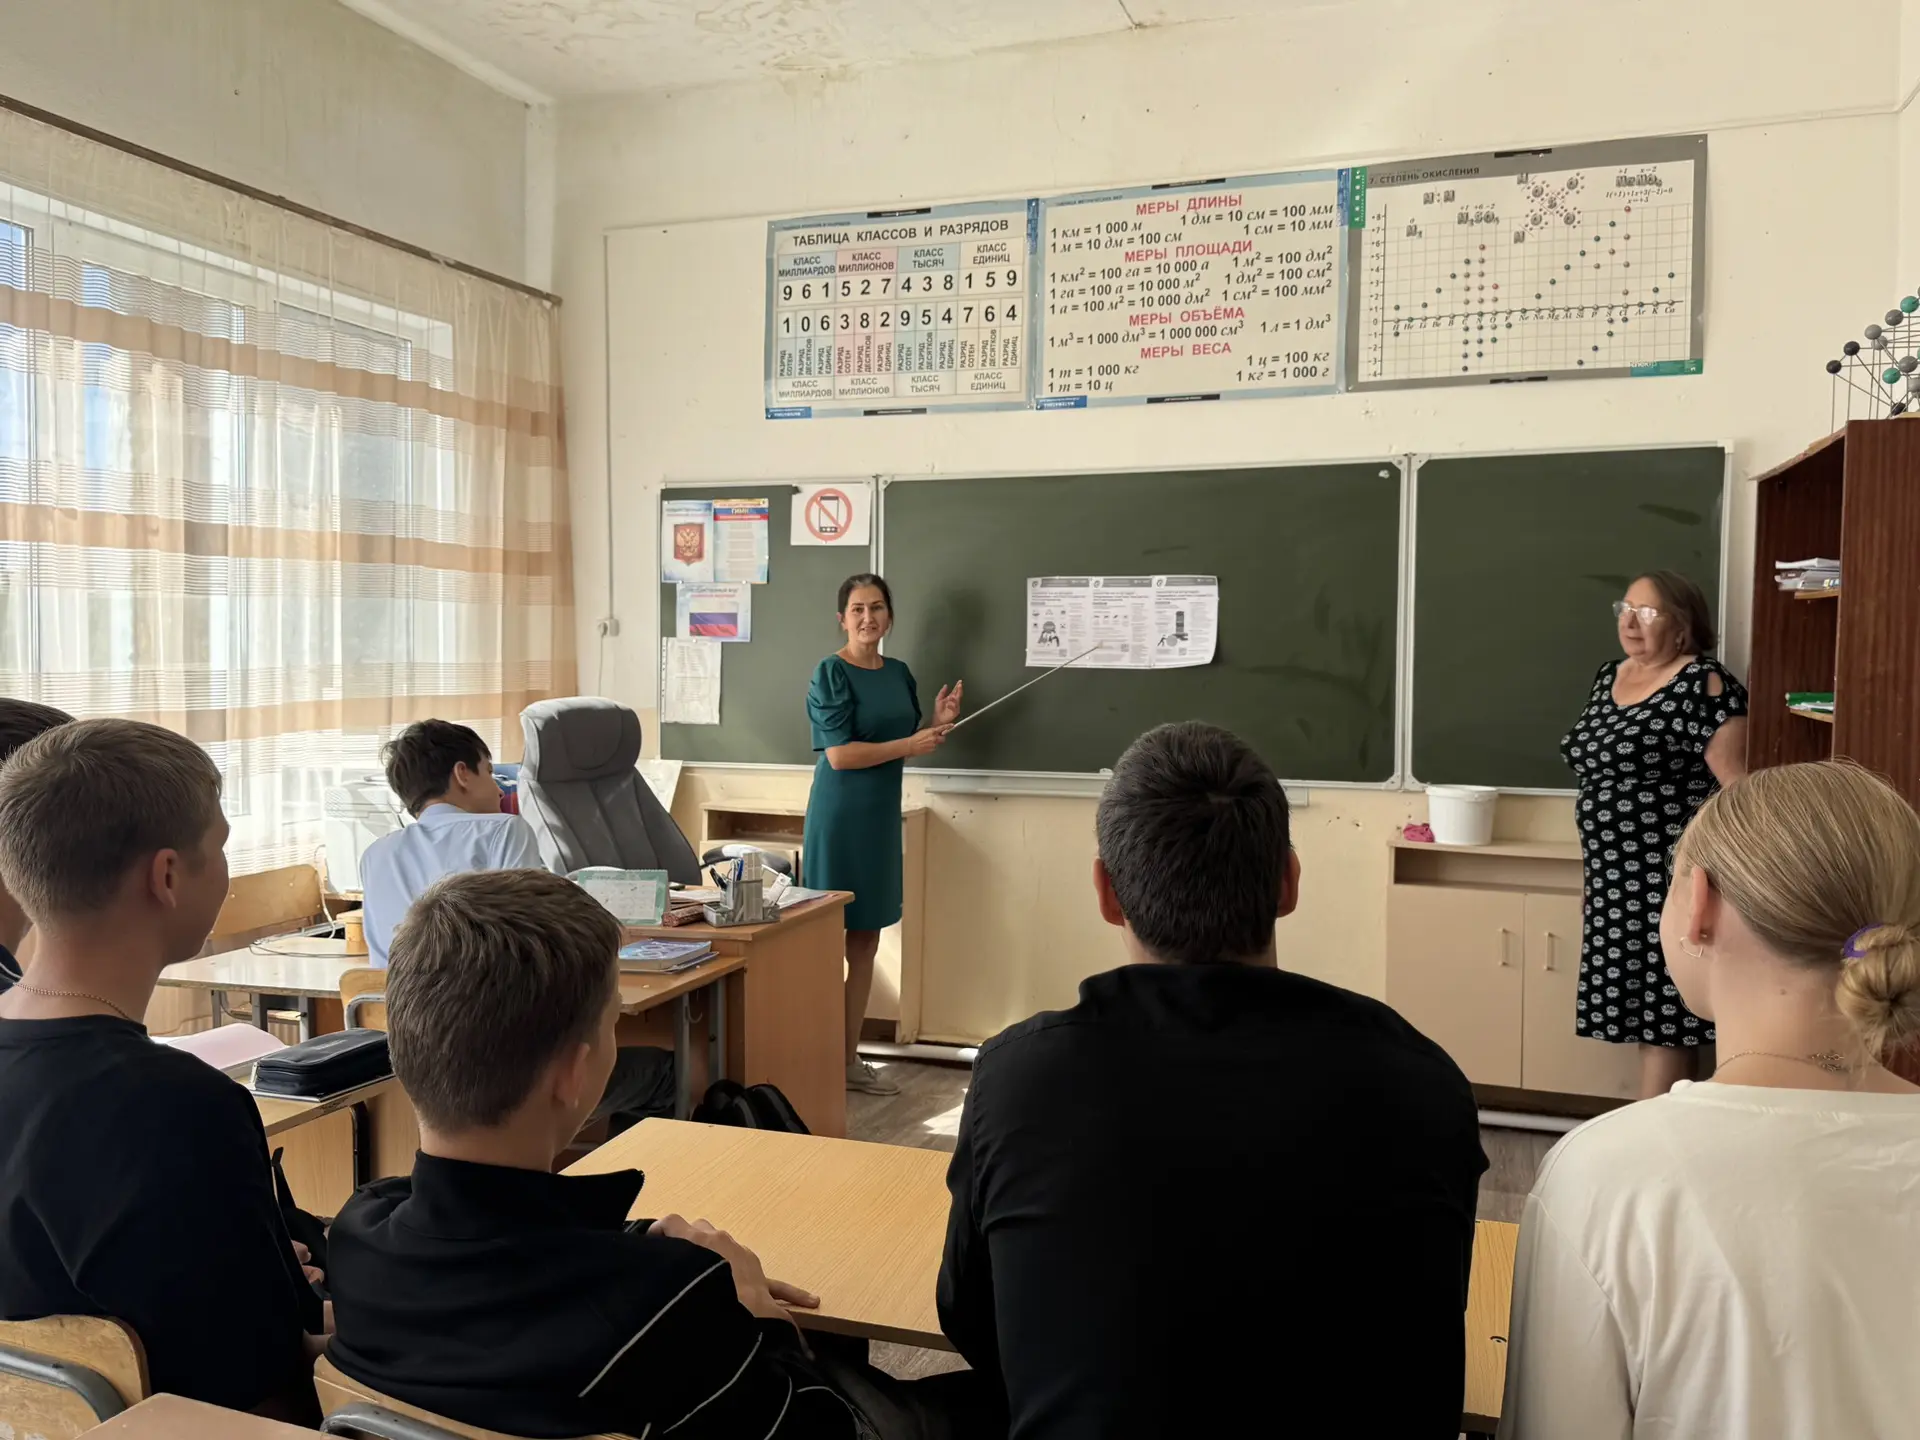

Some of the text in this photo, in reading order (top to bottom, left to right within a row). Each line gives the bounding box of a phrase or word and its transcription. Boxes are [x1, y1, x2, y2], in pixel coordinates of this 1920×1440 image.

[1380, 173, 1419, 184] СТЕПЕНЬ
[1422, 167, 1480, 178] ОКИСЛЕНИЯ
[1136, 200, 1179, 215] МЕРЫ
[1187, 195, 1242, 212] ДЛИНЫ
[1191, 212, 1211, 225] дм
[1228, 210, 1243, 222] 10
[1247, 210, 1265, 221] см
[1282, 205, 1306, 218] 100
[1309, 204, 1333, 216] мм
[793, 220, 1009, 247] ТАБЛИЦА КЛАССОВ И РАЗРЯДОВ
[1061, 228, 1080, 238] км
[1106, 221, 1128, 234] 000
[1131, 222, 1143, 232] м
[1254, 224, 1273, 235] см
[1290, 220, 1305, 232] 10
[1308, 219, 1333, 231] мм
[977, 243, 1007, 253] КЛАСС
[1060, 243, 1071, 253] м
[1087, 238, 1101, 251] 10
[1104, 236, 1123, 249] дм
[1139, 232, 1161, 245] 100
[1165, 232, 1183, 243] см
[852, 252, 881, 261] КЛАСС
[914, 248, 944, 258] КЛАСС
[1124, 240, 1252, 263] МЕРЫ ПЛОЩАДИ
[1278, 252, 1301, 264] 100
[793, 256, 821, 265] КЛАСС
[912, 258, 945, 268] ТЫСЯЧ
[973, 253, 1010, 265] ЕДИНИЦ
[778, 265, 836, 277] МИЛЛИАРДОВ
[838, 262, 894, 273] МИЛЛИОНОВ
[1100, 267, 1122, 280] 100
[1125, 268, 1140, 278] га
[1156, 262, 1171, 274] 10
[1174, 260, 1196, 273] 000
[1279, 267, 1302, 280] 100
[783, 270, 1017, 301] 9 6 1 5 2 7 4 3 8 1 5 9
[1060, 288, 1074, 299] га
[1090, 284, 1112, 297] 100
[1139, 279, 1153, 292] 10
[1157, 278, 1180, 291] 000
[1274, 285, 1298, 298] 100
[1083, 300, 1105, 313] 100
[1139, 296, 1154, 308] 10
[1158, 294, 1181, 306] 000
[783, 304, 1017, 333] 1 0 6 3 8 2 9 5 4 7 6 4
[1129, 306, 1245, 327] МЕРЫ ОБЪЁМА
[1097, 332, 1119, 344] 000
[1169, 326, 1192, 339] 000
[1195, 325, 1217, 338] 000
[989, 329, 997, 367] ДЕСЯТКОВ
[1141, 342, 1232, 359] МЕРЫ ВЕСА
[1258, 356, 1267, 368] ц
[1284, 351, 1308, 364] 100
[1313, 351, 1330, 362] кг
[974, 372, 1003, 380] КЛАСС
[1098, 364, 1120, 376] 000
[1124, 365, 1140, 375] кг
[1248, 371, 1263, 381] кг
[1293, 366, 1317, 378] 000
[1322, 367, 1329, 377] г
[792, 380, 819, 388] КЛАСС
[851, 378, 878, 386] КЛАСС
[911, 375, 939, 383] КЛАСС
[839, 387, 890, 396] МИЛЛИОНОВ
[911, 385, 940, 393] ТЫСЯЧ
[971, 382, 1006, 391] ЕДИНИЦ
[1087, 380, 1100, 391] 10
[1104, 381, 1114, 392] ц
[779, 389, 832, 398] МИЛЛИАРДОВ
